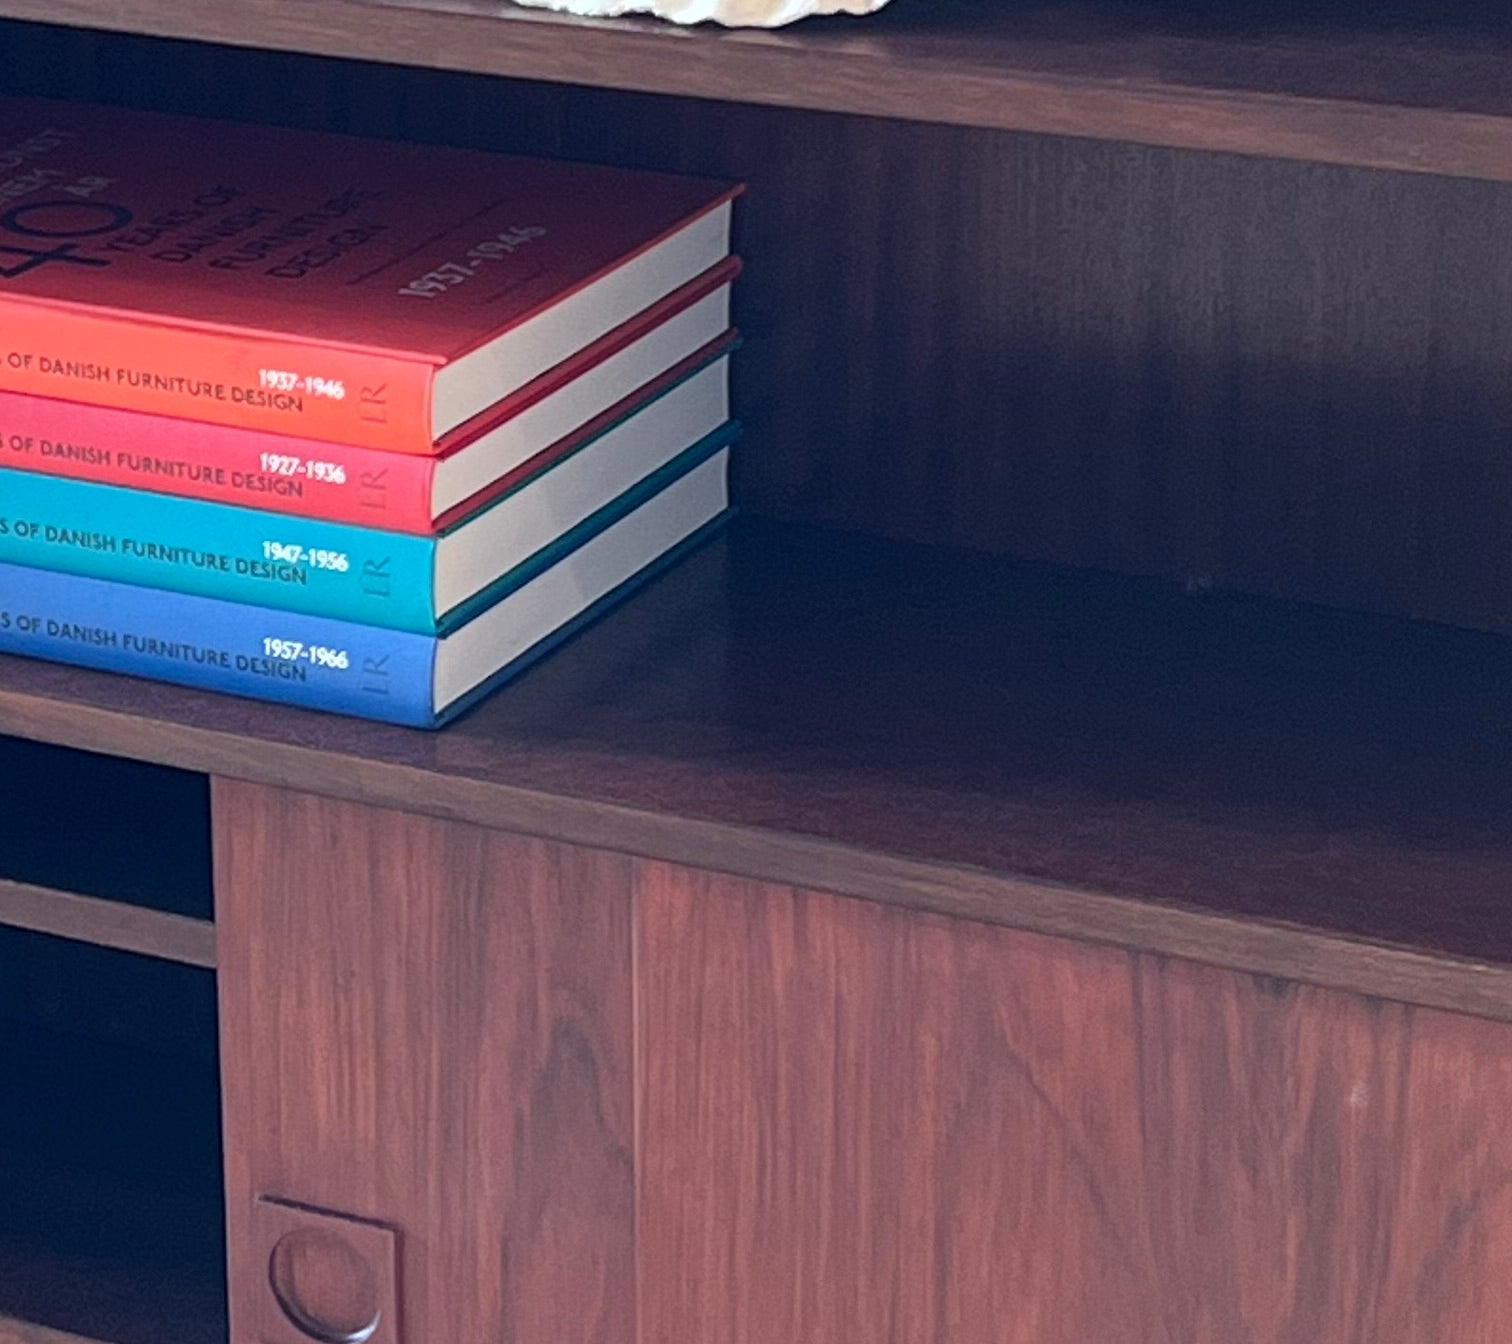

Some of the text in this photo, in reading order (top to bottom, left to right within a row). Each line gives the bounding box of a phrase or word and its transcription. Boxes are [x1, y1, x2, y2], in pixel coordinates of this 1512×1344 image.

[265, 222, 388, 278] DESIGN
[8, 353, 32, 369] OF
[39, 356, 109, 381] DANISH
[116, 368, 226, 401] FURNITURE
[230, 386, 303, 412] DESIGN
[259, 369, 345, 400] 1937-1946
[9, 436, 34, 453] OF
[40, 441, 110, 466] DANISH
[117, 452, 226, 485] FURNITURE
[231, 471, 303, 497] DESIGN
[259, 452, 347, 484] 1927-1936
[14, 521, 38, 538] OF
[45, 525, 116, 553] DANISH
[122, 538, 230, 572] FURNITURE
[235, 557, 307, 585] DESIGN
[262, 540, 349, 572] 1947-1956
[16, 616, 40, 633] OF
[47, 621, 116, 647] DANISH
[122, 634, 231, 668] FURNITURE
[235, 654, 307, 682] DESIGN
[263, 637, 349, 669] 1957-1966
